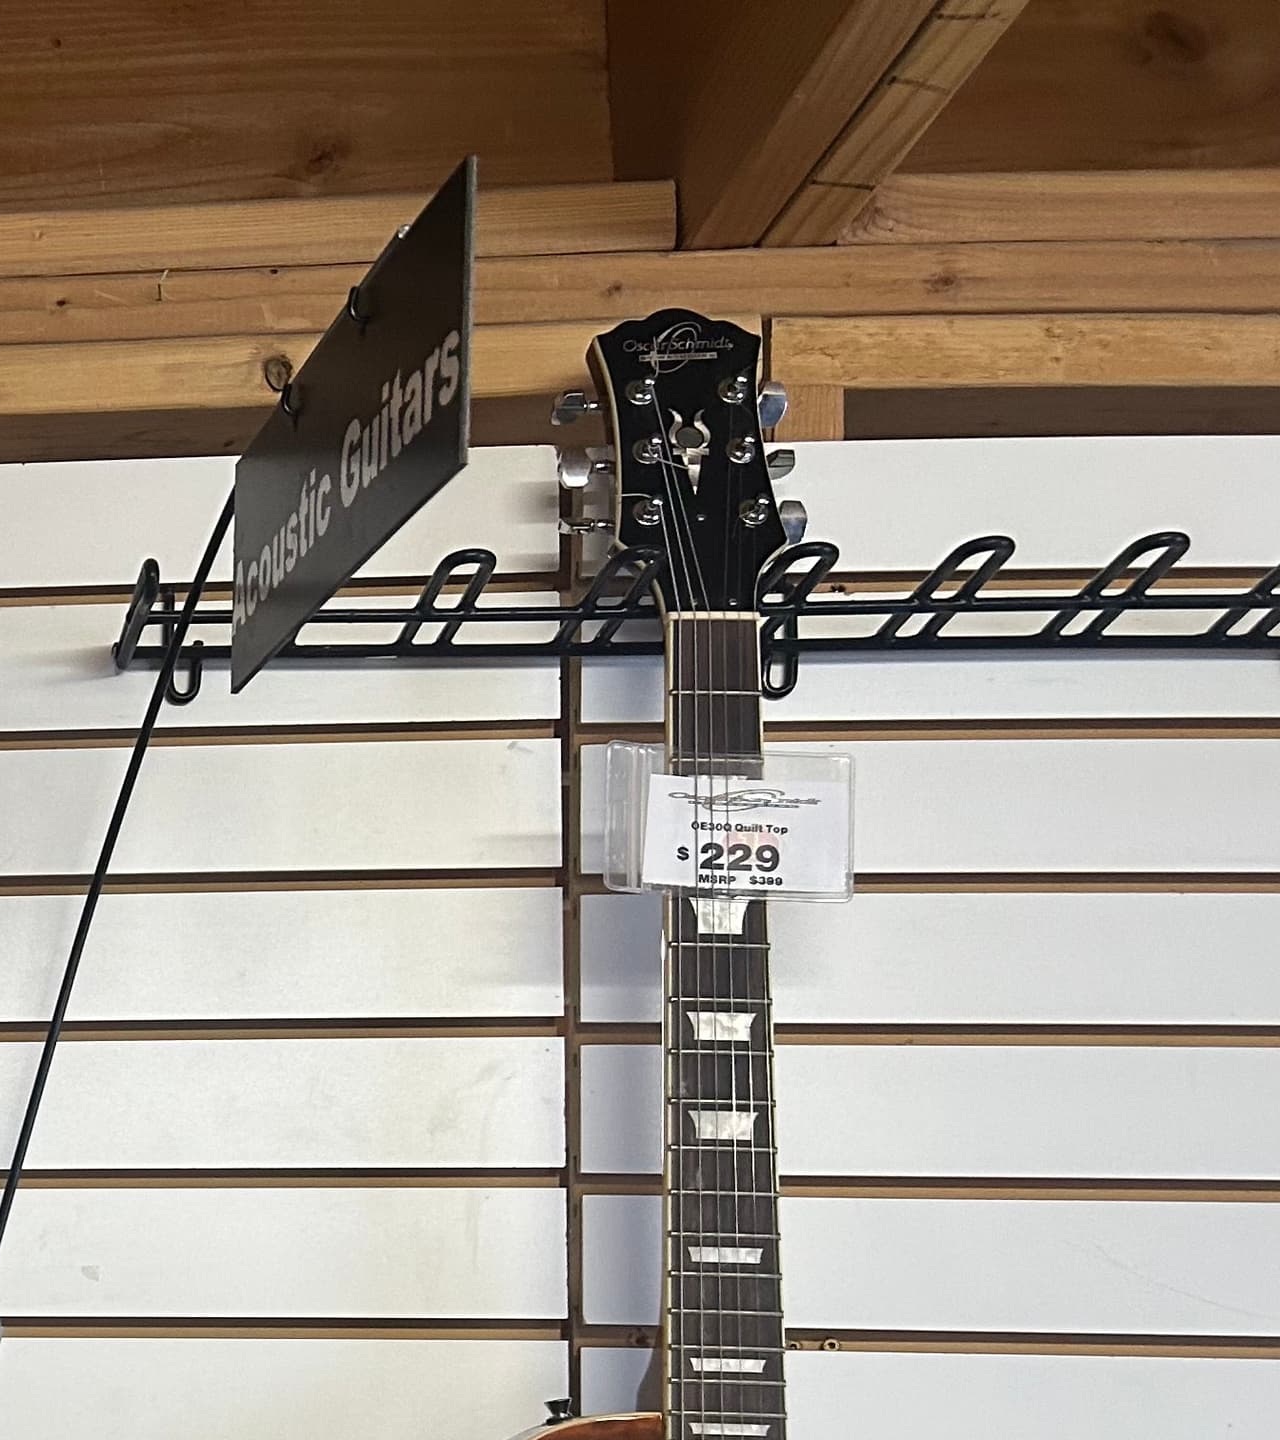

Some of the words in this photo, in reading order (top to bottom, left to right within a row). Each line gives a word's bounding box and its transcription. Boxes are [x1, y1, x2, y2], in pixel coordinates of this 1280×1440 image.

[231, 466, 332, 637] Acoustic
[340, 328, 461, 508] Guitars
[734, 823, 764, 833] Quilt
[766, 824, 789, 835] Top
[676, 845, 690, 861] $
[699, 842, 780, 873] 229
[698, 874, 737, 885] MSRP
